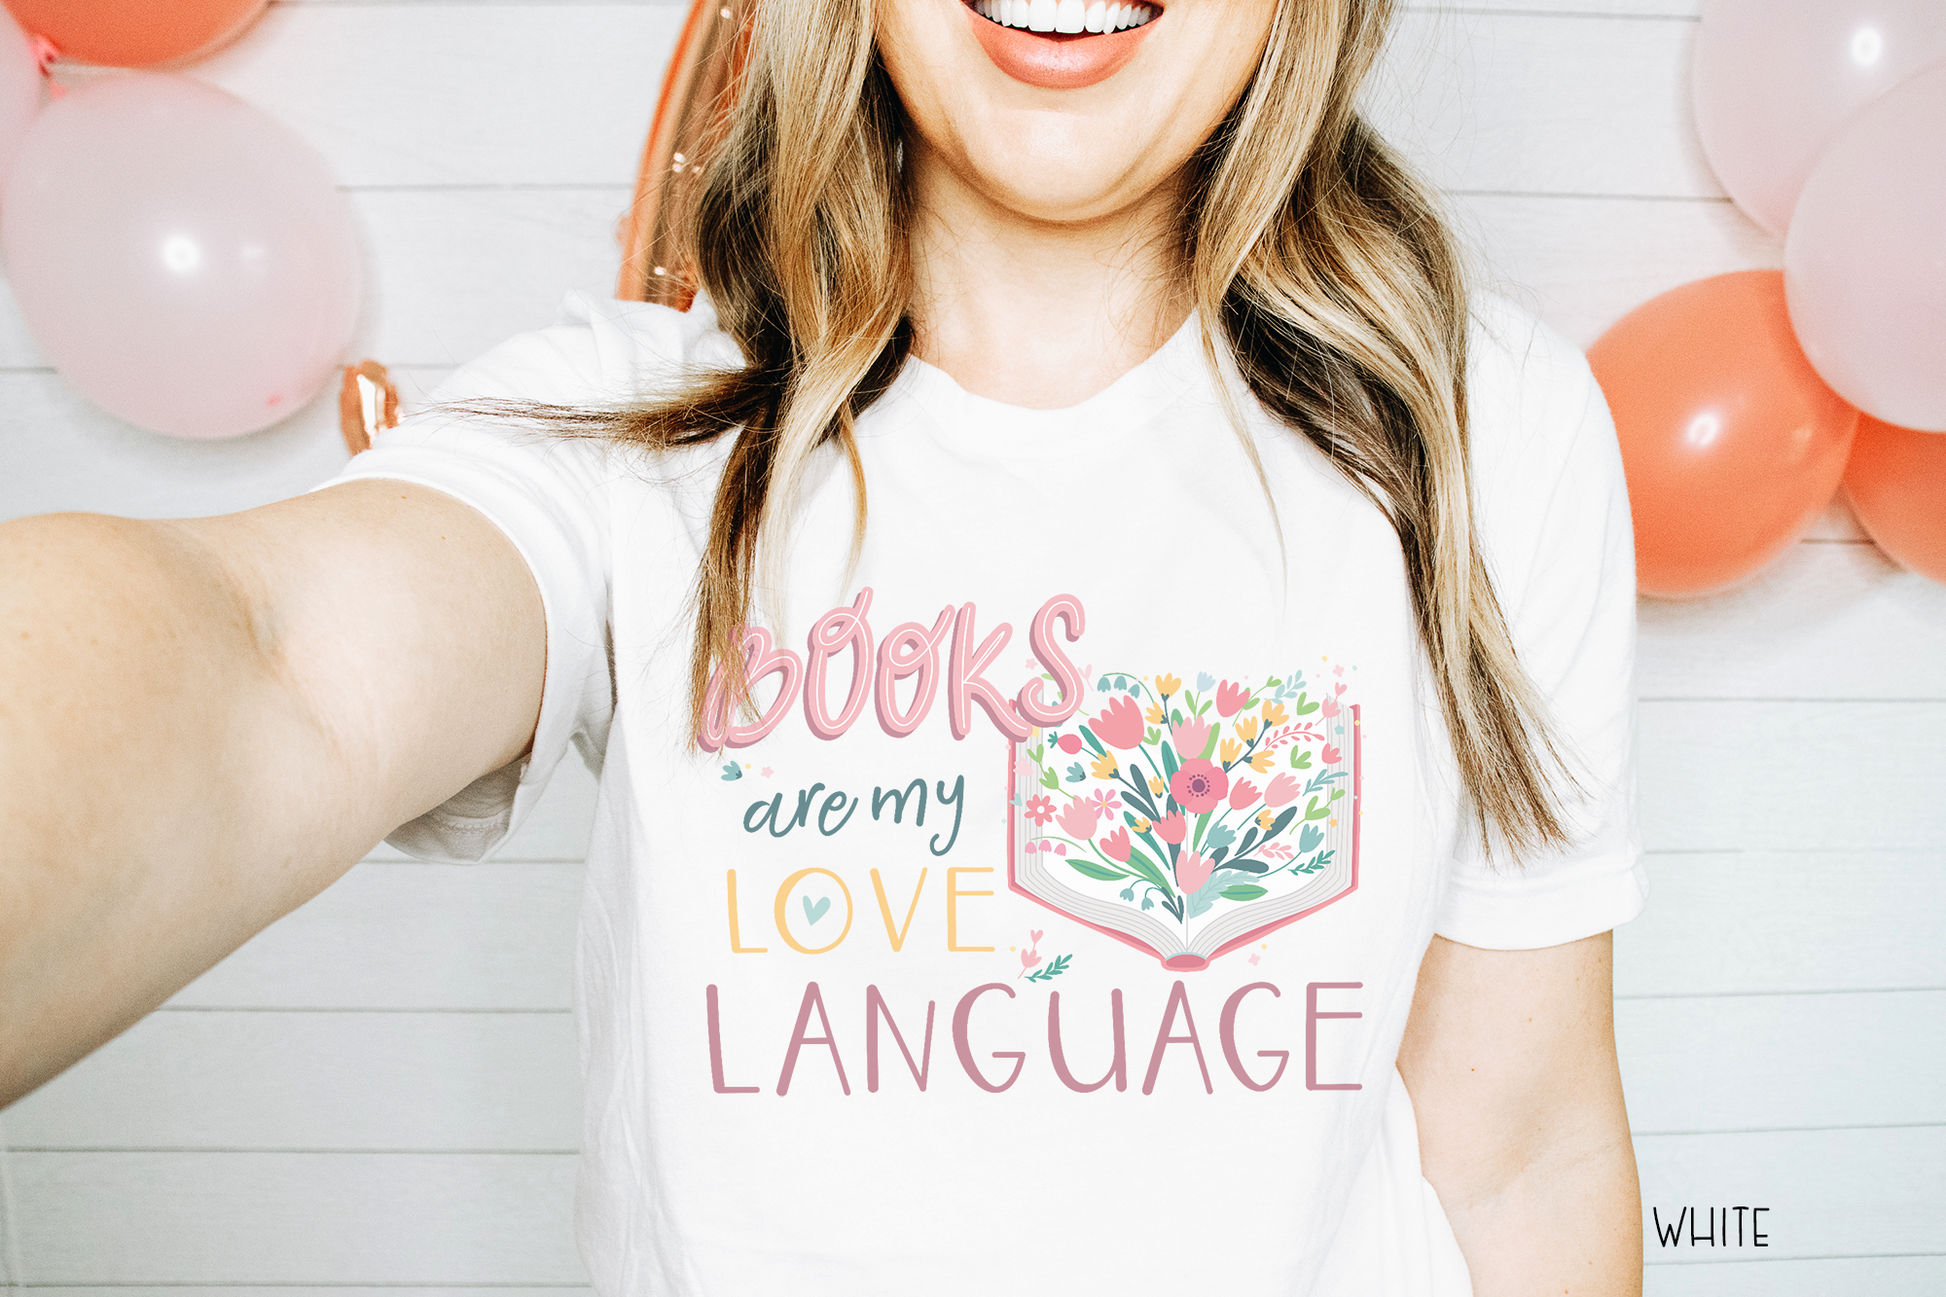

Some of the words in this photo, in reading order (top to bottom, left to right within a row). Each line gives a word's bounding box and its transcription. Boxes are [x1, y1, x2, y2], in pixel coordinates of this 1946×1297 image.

[698, 586, 1086, 753] BOOKS
[743, 782, 859, 838] are
[871, 774, 964, 856] my
[726, 866, 995, 955] LOVE
[705, 980, 1363, 1097] LANGUAGE
